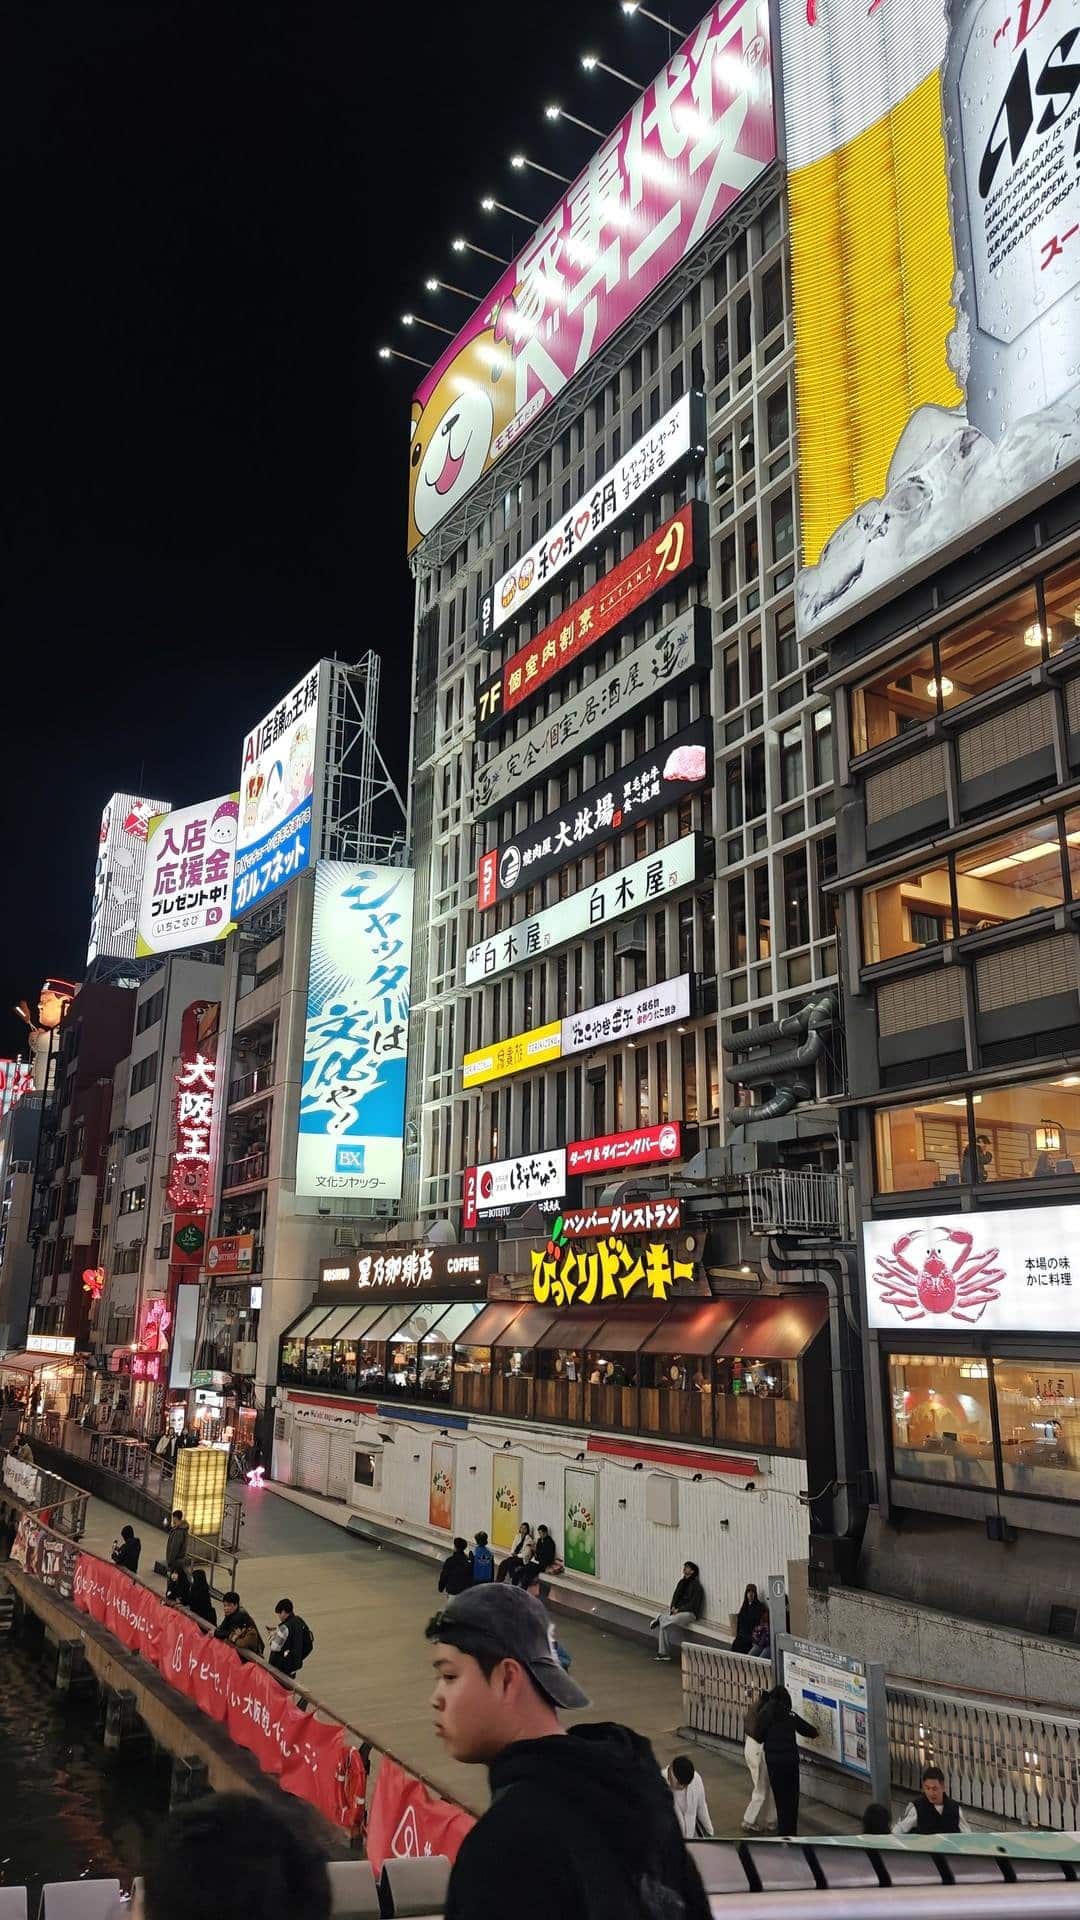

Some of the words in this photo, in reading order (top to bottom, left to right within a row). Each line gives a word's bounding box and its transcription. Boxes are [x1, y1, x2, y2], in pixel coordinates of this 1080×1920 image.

[1032, 136, 1050, 162] DRY
[480, 682, 501, 722] 7F
[600, 562, 652, 612] KATANA
[655, 521, 685, 581] 刀
[157, 819, 207, 861] 入店
[553, 793, 615, 854] 大牧場
[153, 848, 230, 897] 応援金
[235, 834, 306, 911] ガルフネット
[484, 922, 541, 973] 白木屋
[589, 859, 665, 925] 白木屋
[315, 1176, 387, 1190] 文化シャッター
[563, 1203, 680, 1233] ハンバーグレストラン
[358, 1249, 434, 1289] 星乃珈琲店
[447, 1255, 480, 1273] COFFEE
[531, 1236, 694, 1307] びっくりドンキー
[1024, 1256, 1071, 1271] 本場の味
[1026, 1272, 1072, 1287] かに料理
